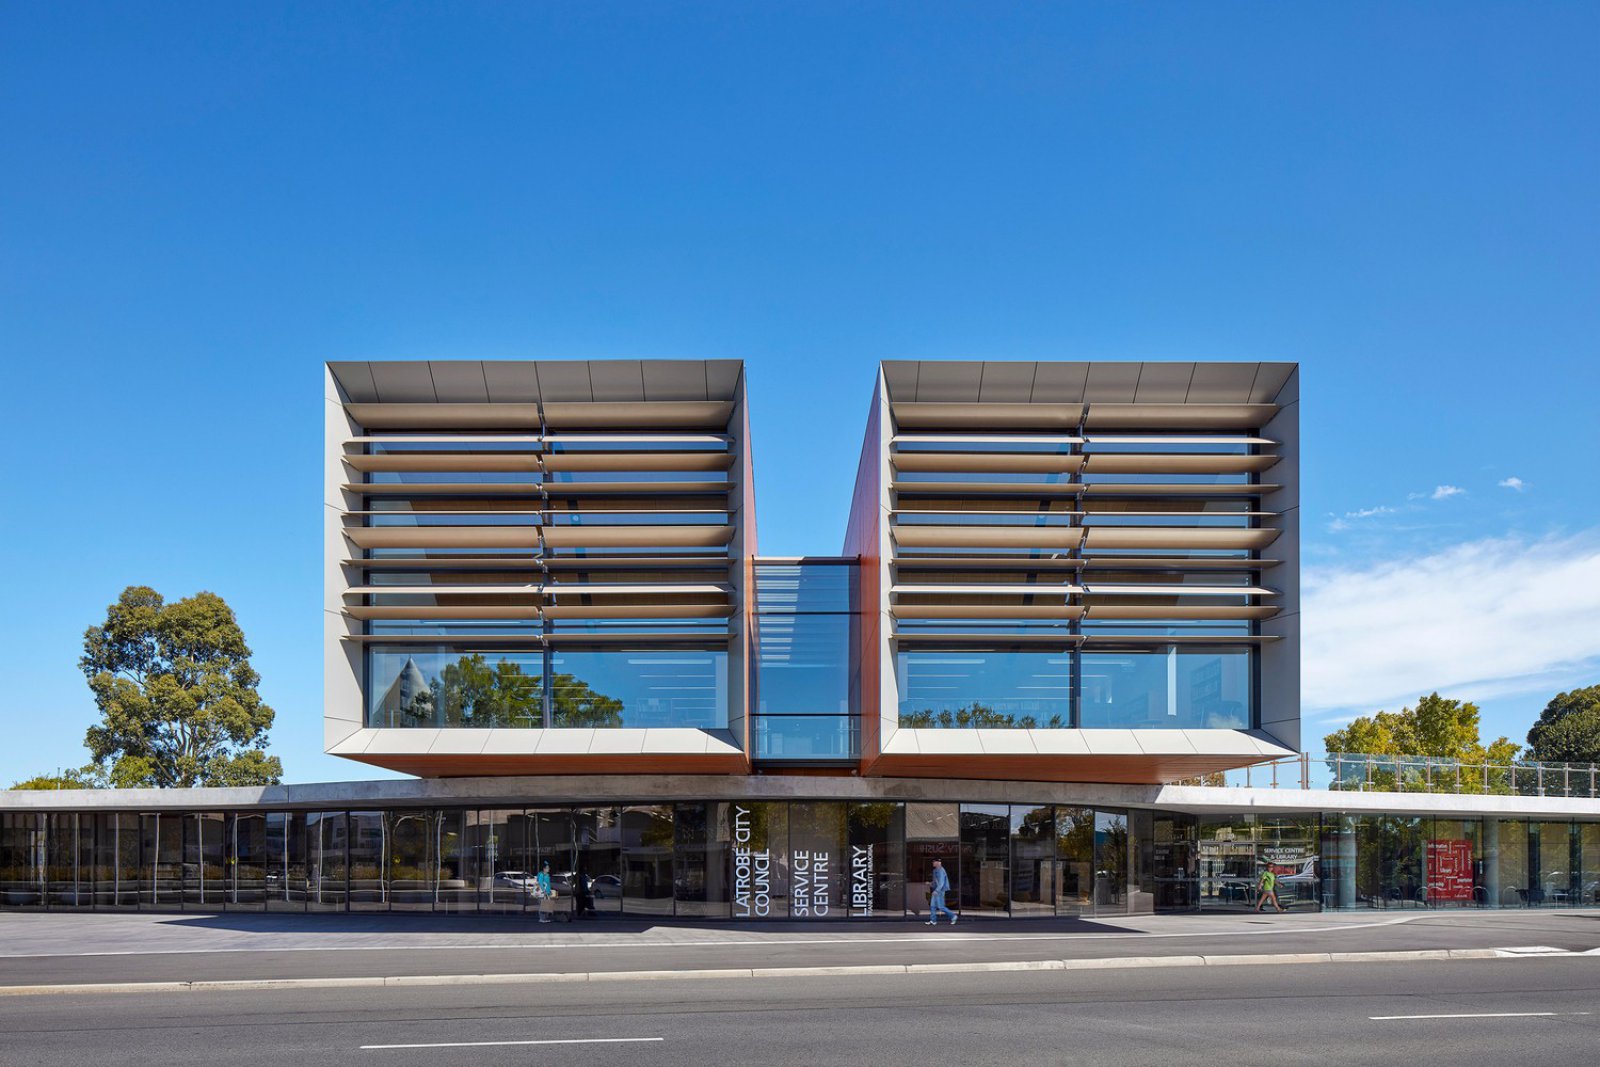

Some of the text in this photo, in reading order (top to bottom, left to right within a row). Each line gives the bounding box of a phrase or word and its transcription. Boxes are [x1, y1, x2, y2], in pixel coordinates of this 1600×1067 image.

[736, 805, 751, 917] LATROBE CITY
[754, 848, 770, 917] COUNCIL
[794, 850, 809, 917] SERVICE
[813, 852, 829, 917] CENTRE
[852, 845, 867, 917] LIBRARY
